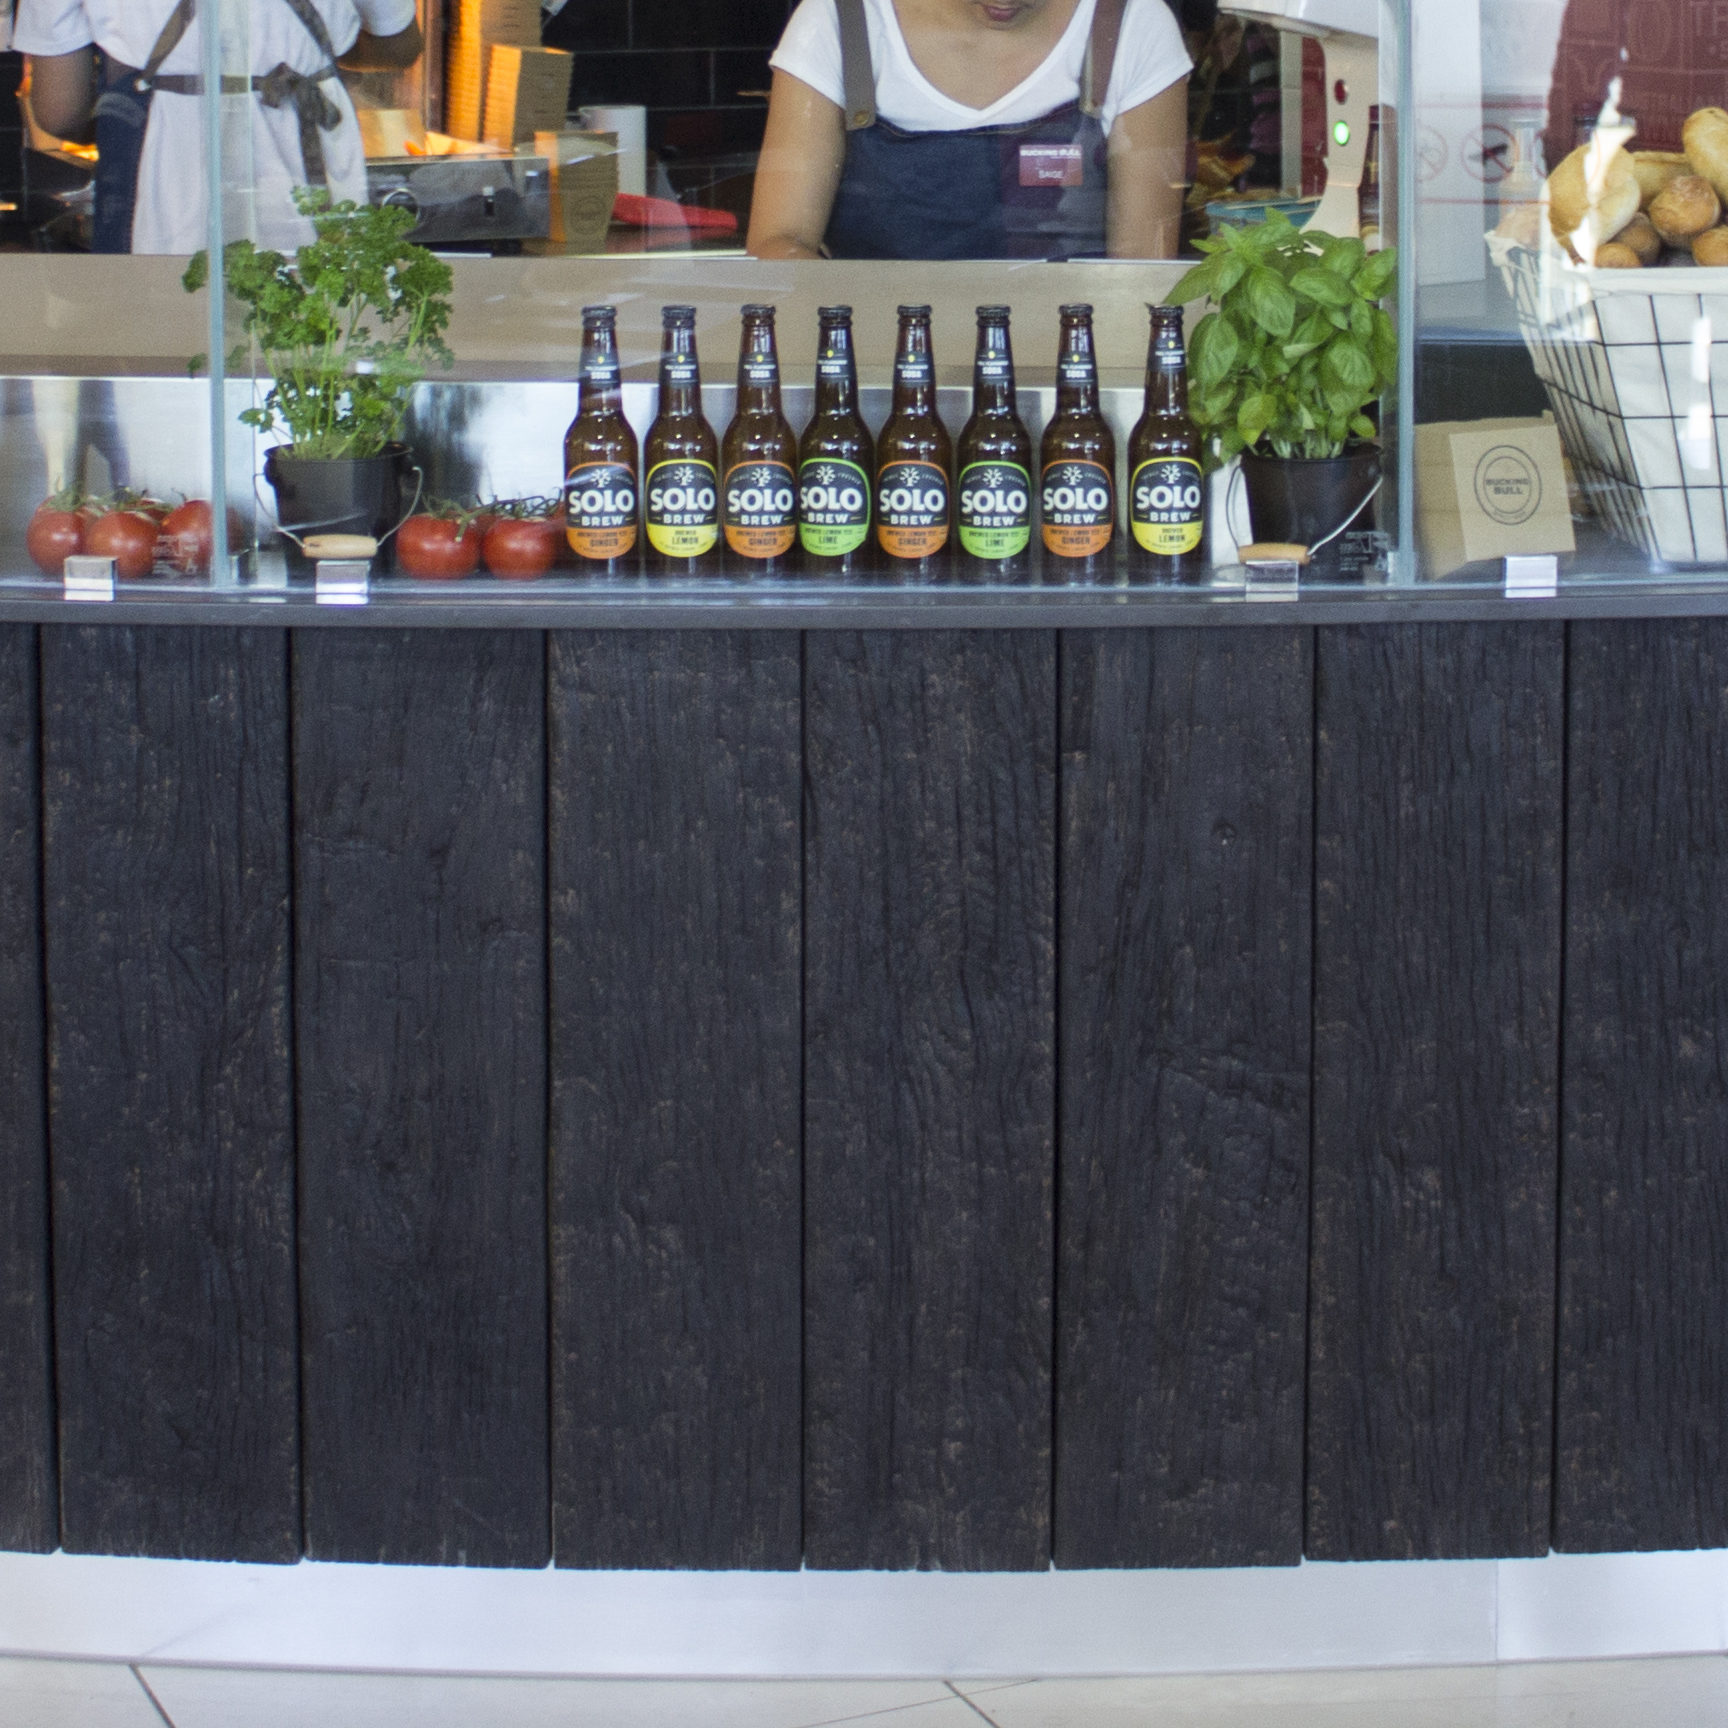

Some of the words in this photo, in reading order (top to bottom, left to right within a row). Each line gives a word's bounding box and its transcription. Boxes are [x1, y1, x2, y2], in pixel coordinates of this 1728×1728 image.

[569, 489, 635, 514] SOLO
[650, 487, 715, 512] SOLO
[727, 489, 793, 513] SOLO
[800, 486, 863, 511] SOLO
[879, 488, 945, 512] SOLO
[961, 489, 1027, 514] SOLO
[1043, 487, 1108, 512] SOLO
[1136, 485, 1201, 510] SOLO
[581, 515, 623, 526] BREW
[663, 513, 706, 524] BREW
[740, 514, 782, 525] BREW
[807, 512, 848, 523] BREW
[890, 514, 933, 525] BREW
[973, 515, 1016, 526] BREW
[1054, 513, 1096, 524] BREW
[1149, 511, 1191, 522] BREW
